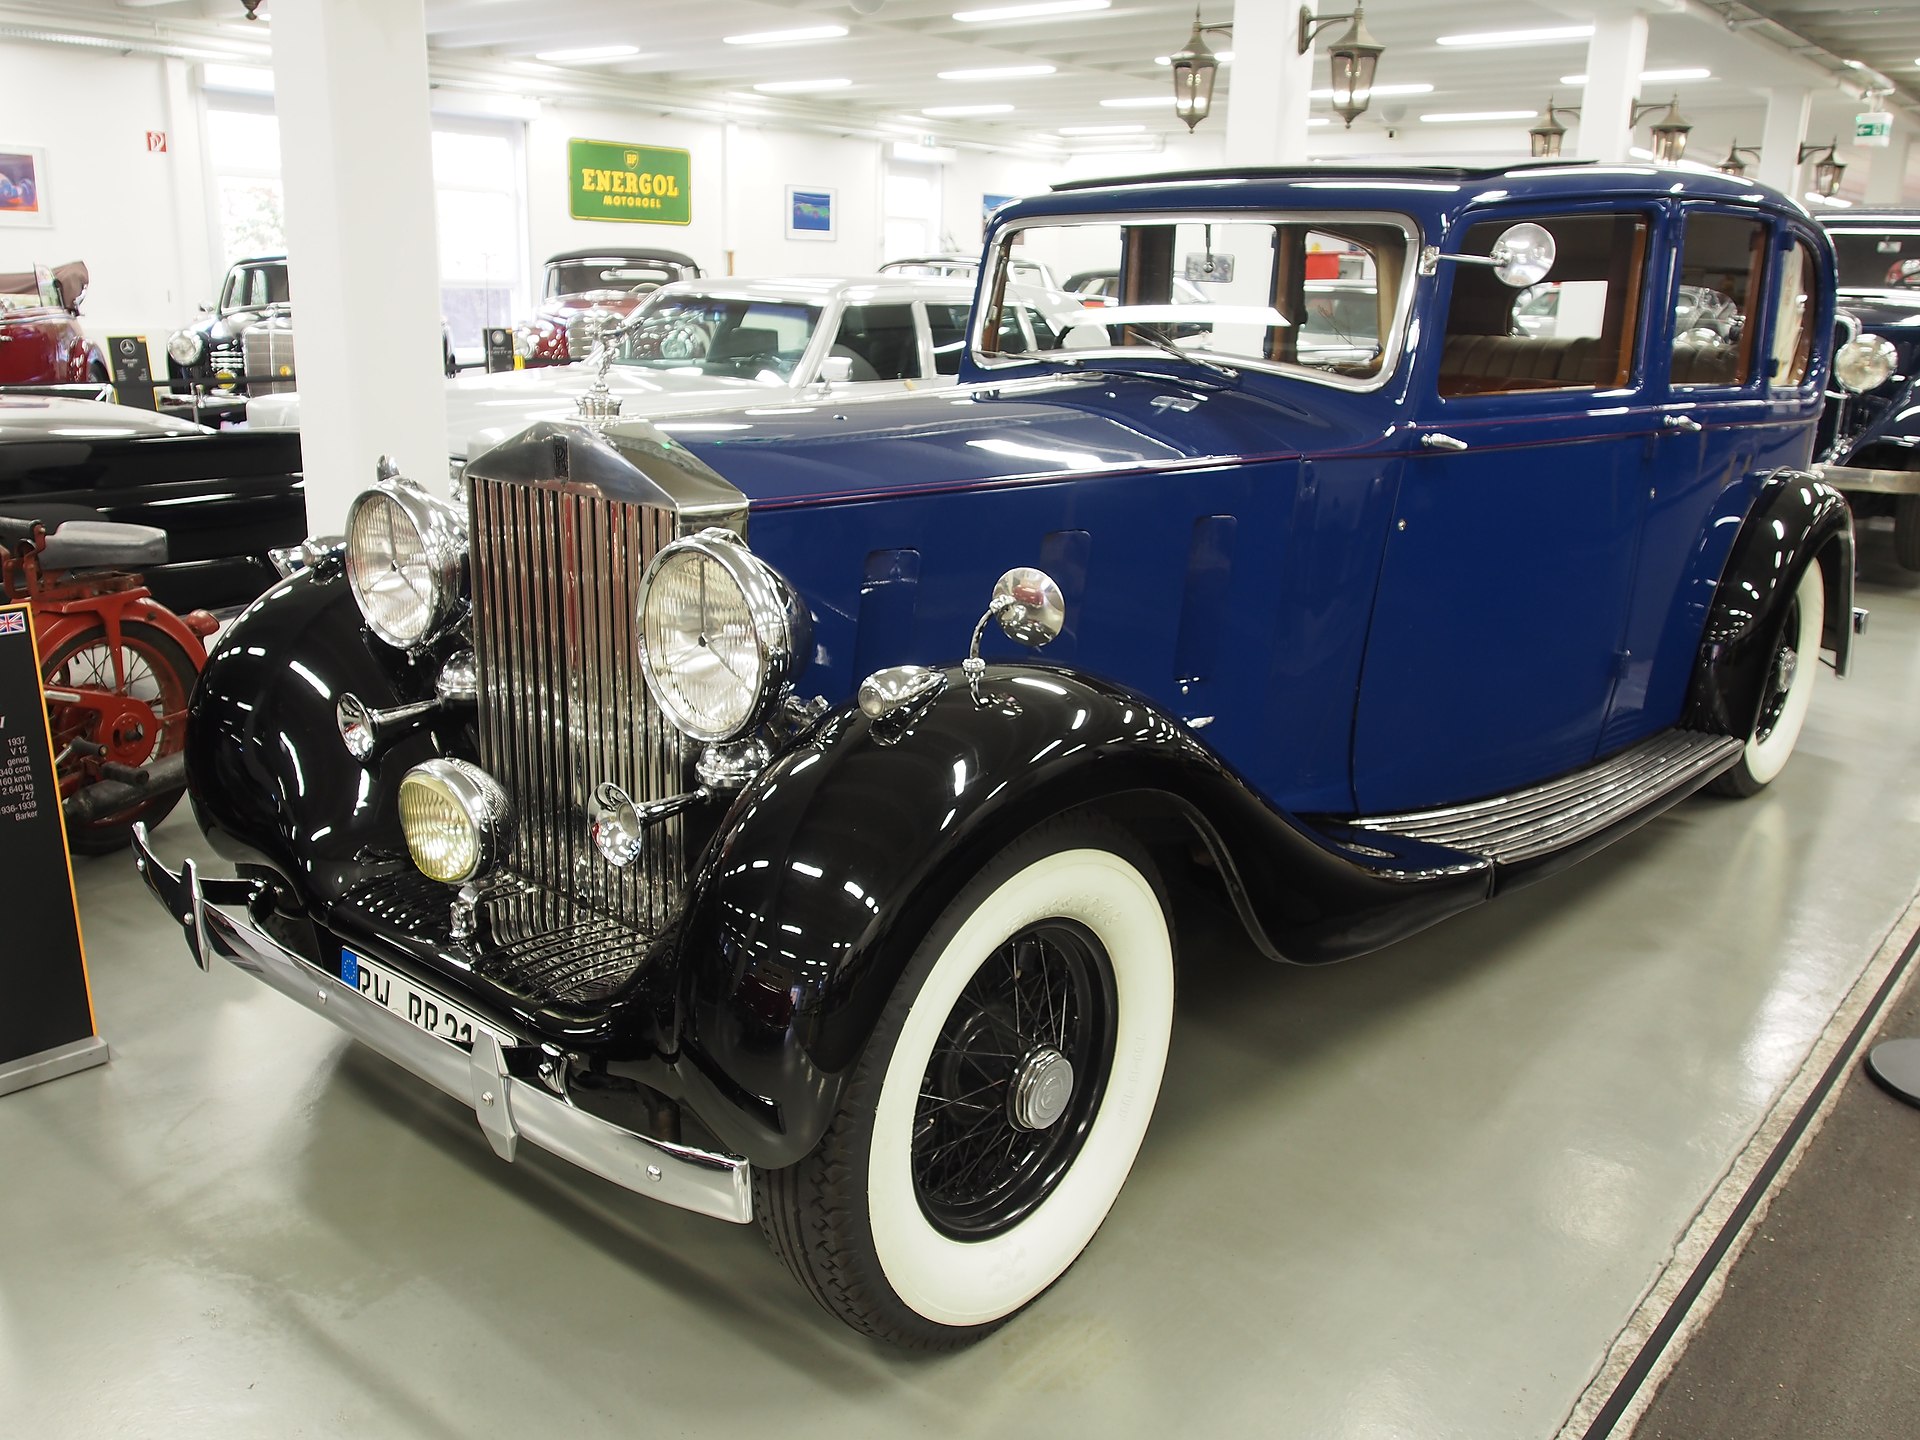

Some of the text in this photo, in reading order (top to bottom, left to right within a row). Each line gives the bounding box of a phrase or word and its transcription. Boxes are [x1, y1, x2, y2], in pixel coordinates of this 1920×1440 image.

[582, 168, 679, 197] ENERGOL
[603, 195, 661, 208] MOTOROEL
[8, 736, 26, 746] 1937
[19, 745, 28, 754] 12
[7, 756, 30, 767] genug
[15, 765, 31, 774] ccm
[14, 773, 33, 783] km/h
[2, 783, 34, 795] 2.640 kg
[20, 791, 35, 800] 727
[15, 810, 38, 821] Barker
